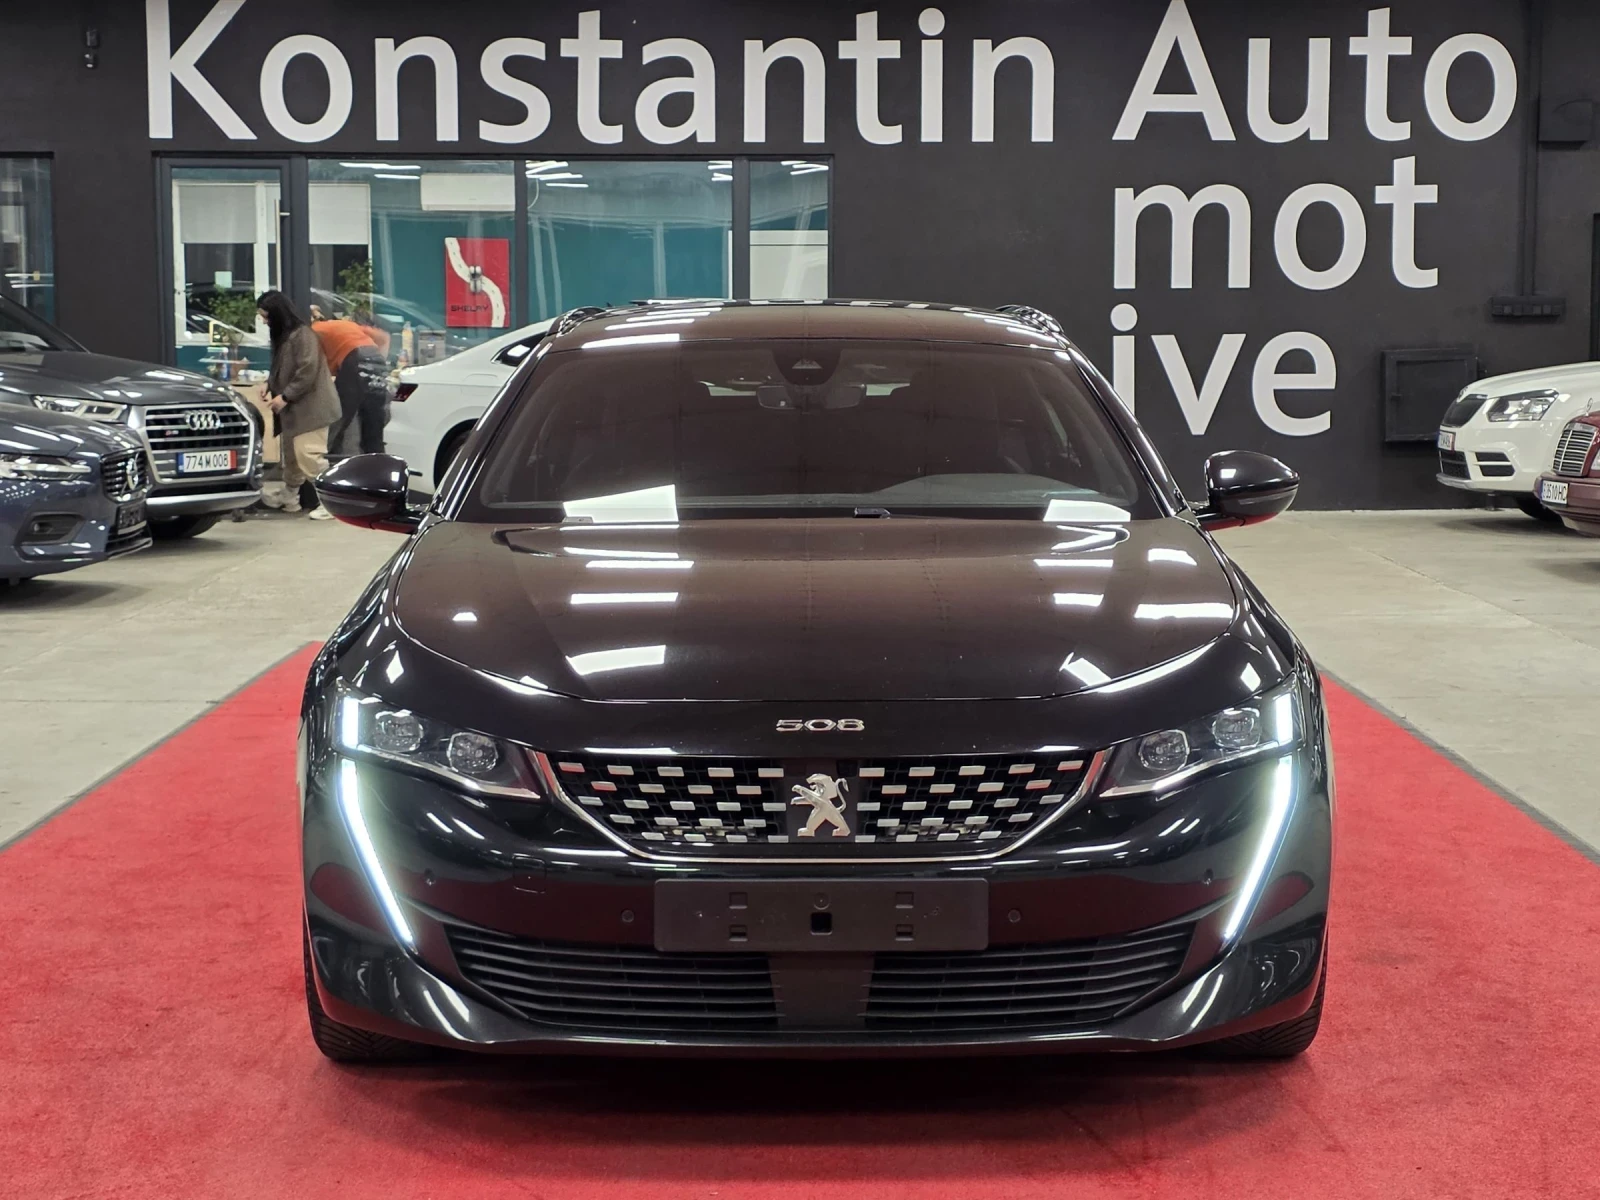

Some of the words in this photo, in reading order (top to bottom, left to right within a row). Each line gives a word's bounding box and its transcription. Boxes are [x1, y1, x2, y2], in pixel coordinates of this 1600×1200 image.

[145, 0, 1055, 145] Konstantin
[1111, 0, 1518, 143] Auto
[1113, 155, 1439, 291] mot
[1110, 303, 1337, 437] ive
[775, 718, 865, 731] 508
